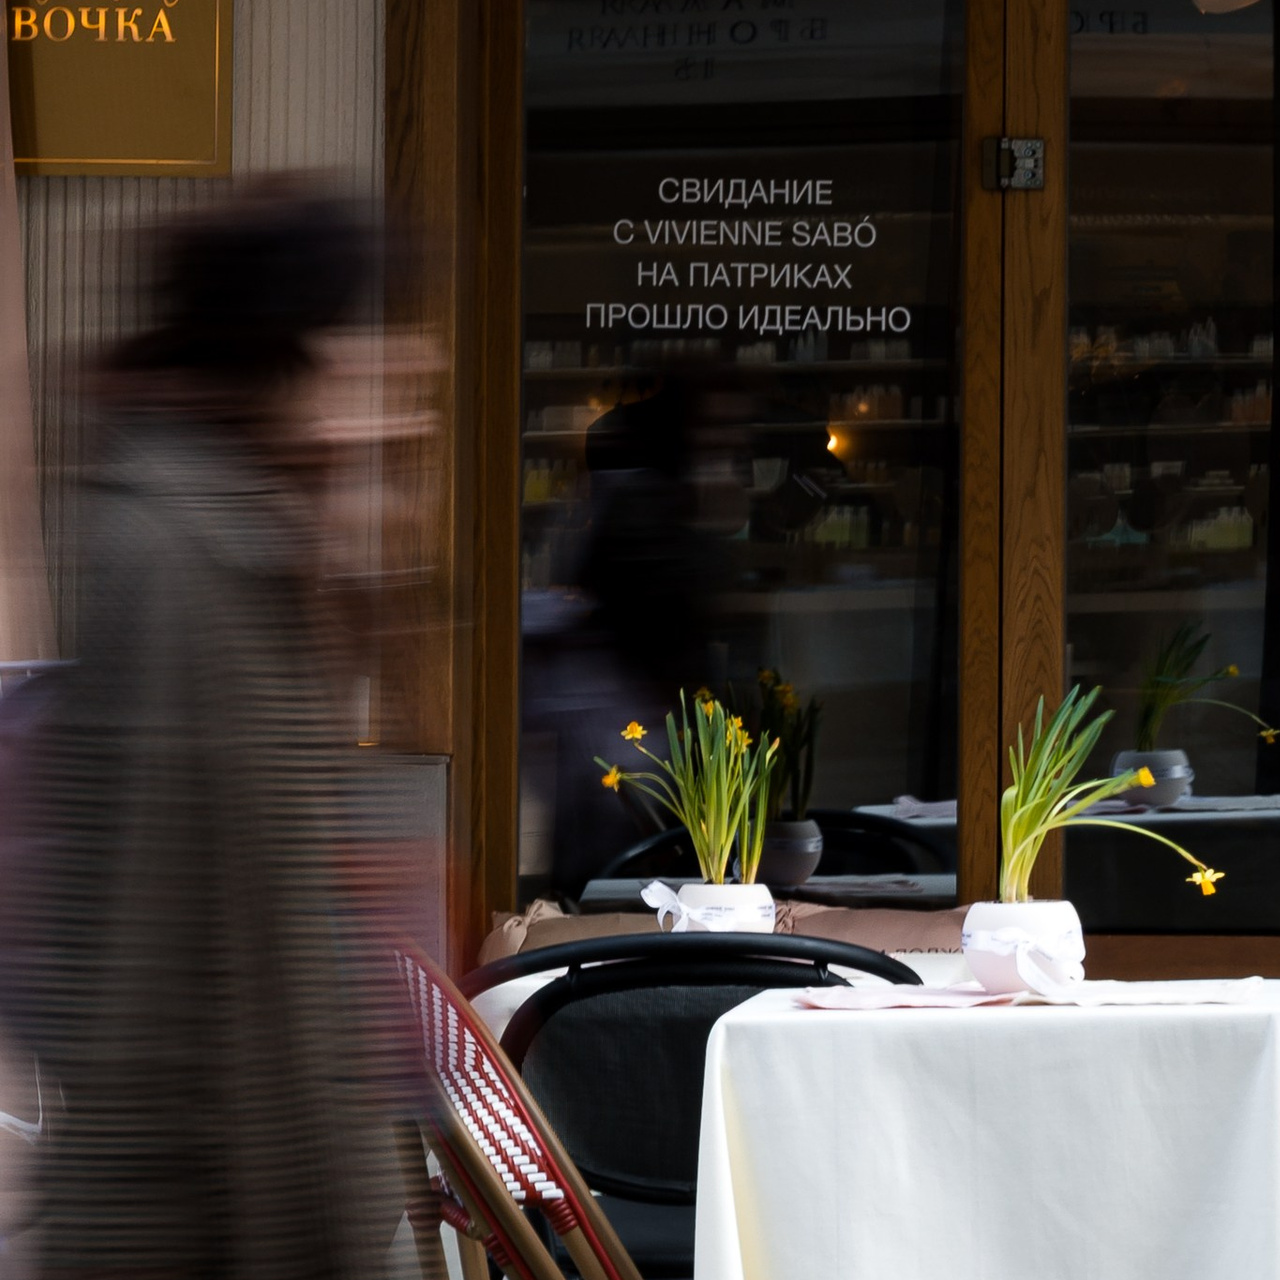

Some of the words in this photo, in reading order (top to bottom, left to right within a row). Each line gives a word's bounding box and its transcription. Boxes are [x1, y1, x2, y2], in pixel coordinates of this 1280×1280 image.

[12, 6, 178, 44] ВОЧКА
[658, 178, 833, 209] СВИДАНИЕ
[643, 220, 783, 247] VIVIENNE
[791, 215, 877, 249] SABÓ
[637, 261, 680, 288] НА
[689, 262, 853, 290] ПАТРИКАХ
[586, 302, 729, 330] ПРОШЛО
[738, 305, 912, 336] ИДЕАЛЬНО
